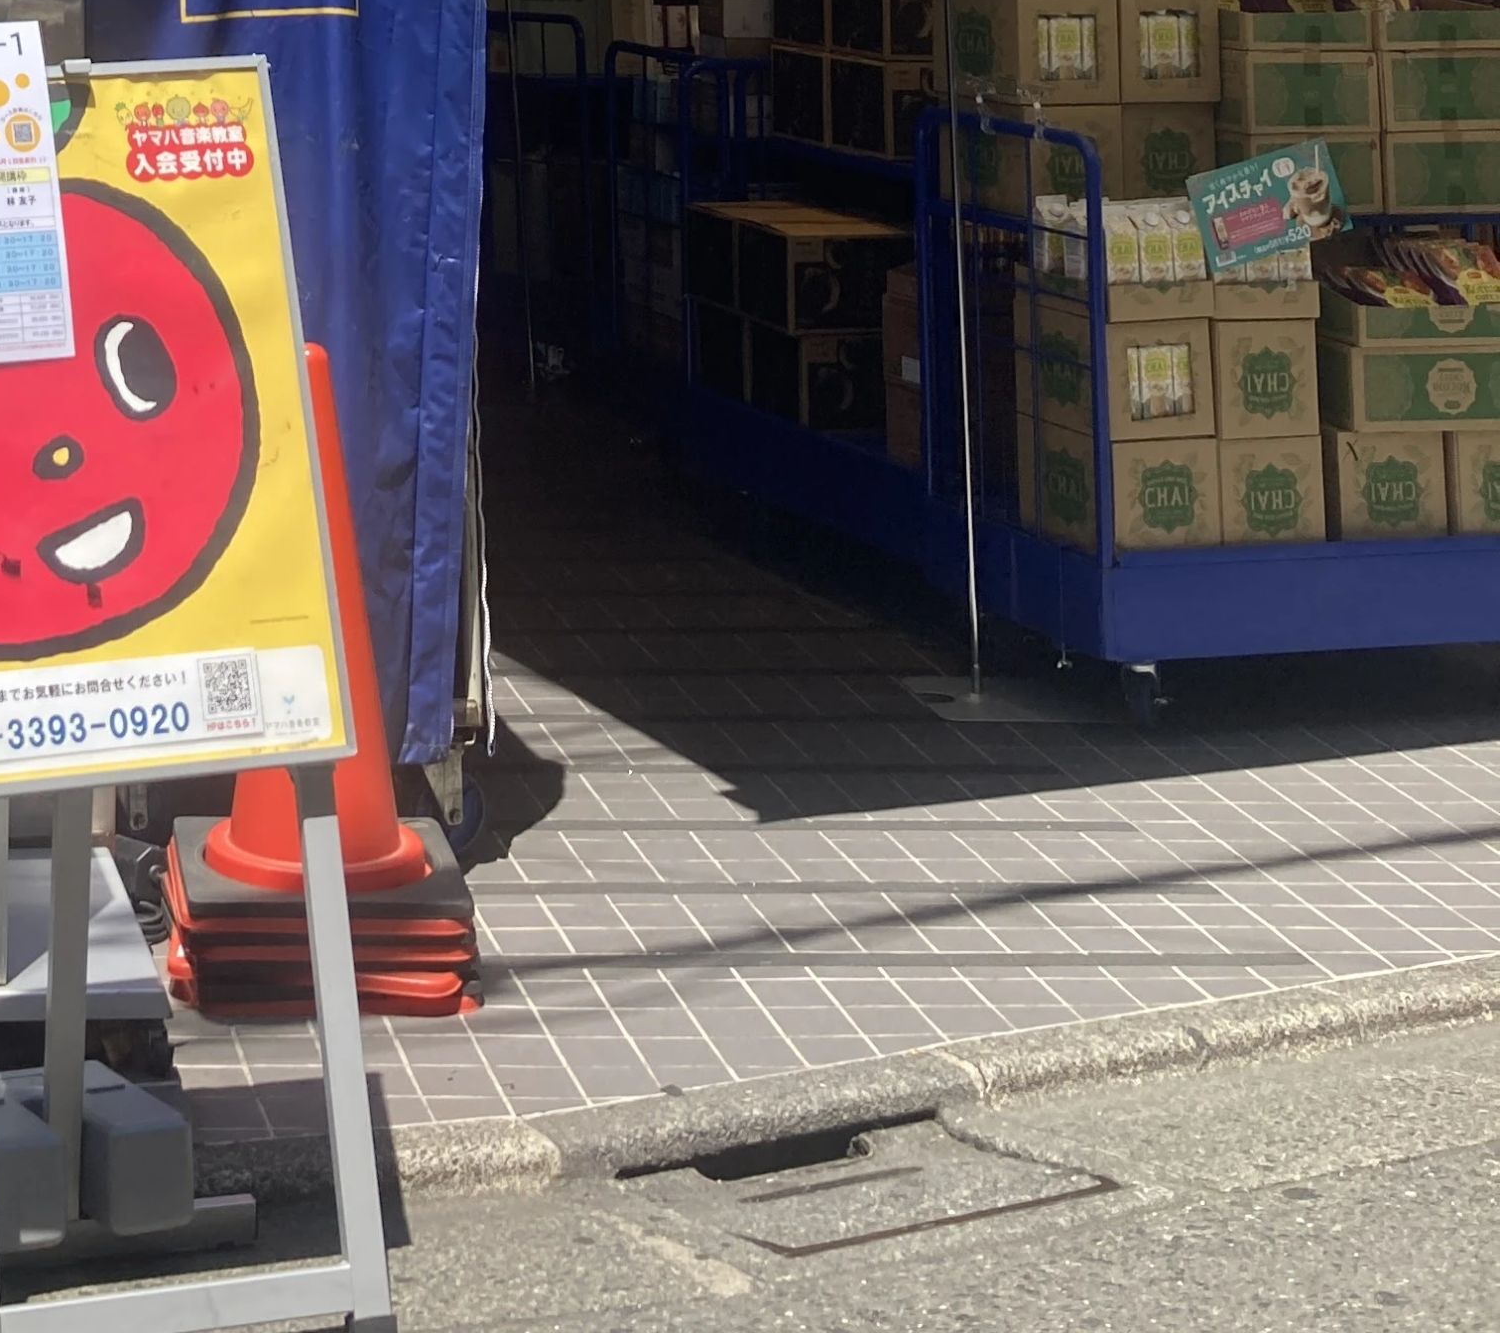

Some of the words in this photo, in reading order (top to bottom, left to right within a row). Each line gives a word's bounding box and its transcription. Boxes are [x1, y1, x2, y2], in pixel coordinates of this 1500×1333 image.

[132, 125, 244, 147] ヤマハ音楽教室
[133, 147, 248, 176] 入会受付中
[1202, 168, 1273, 214] アイスチャイ
[1246, 372, 1290, 392] CHAI
[1145, 485, 1190, 508] CHAI
[1250, 488, 1295, 510] CHAI
[1371, 480, 1417, 502] CHAI
